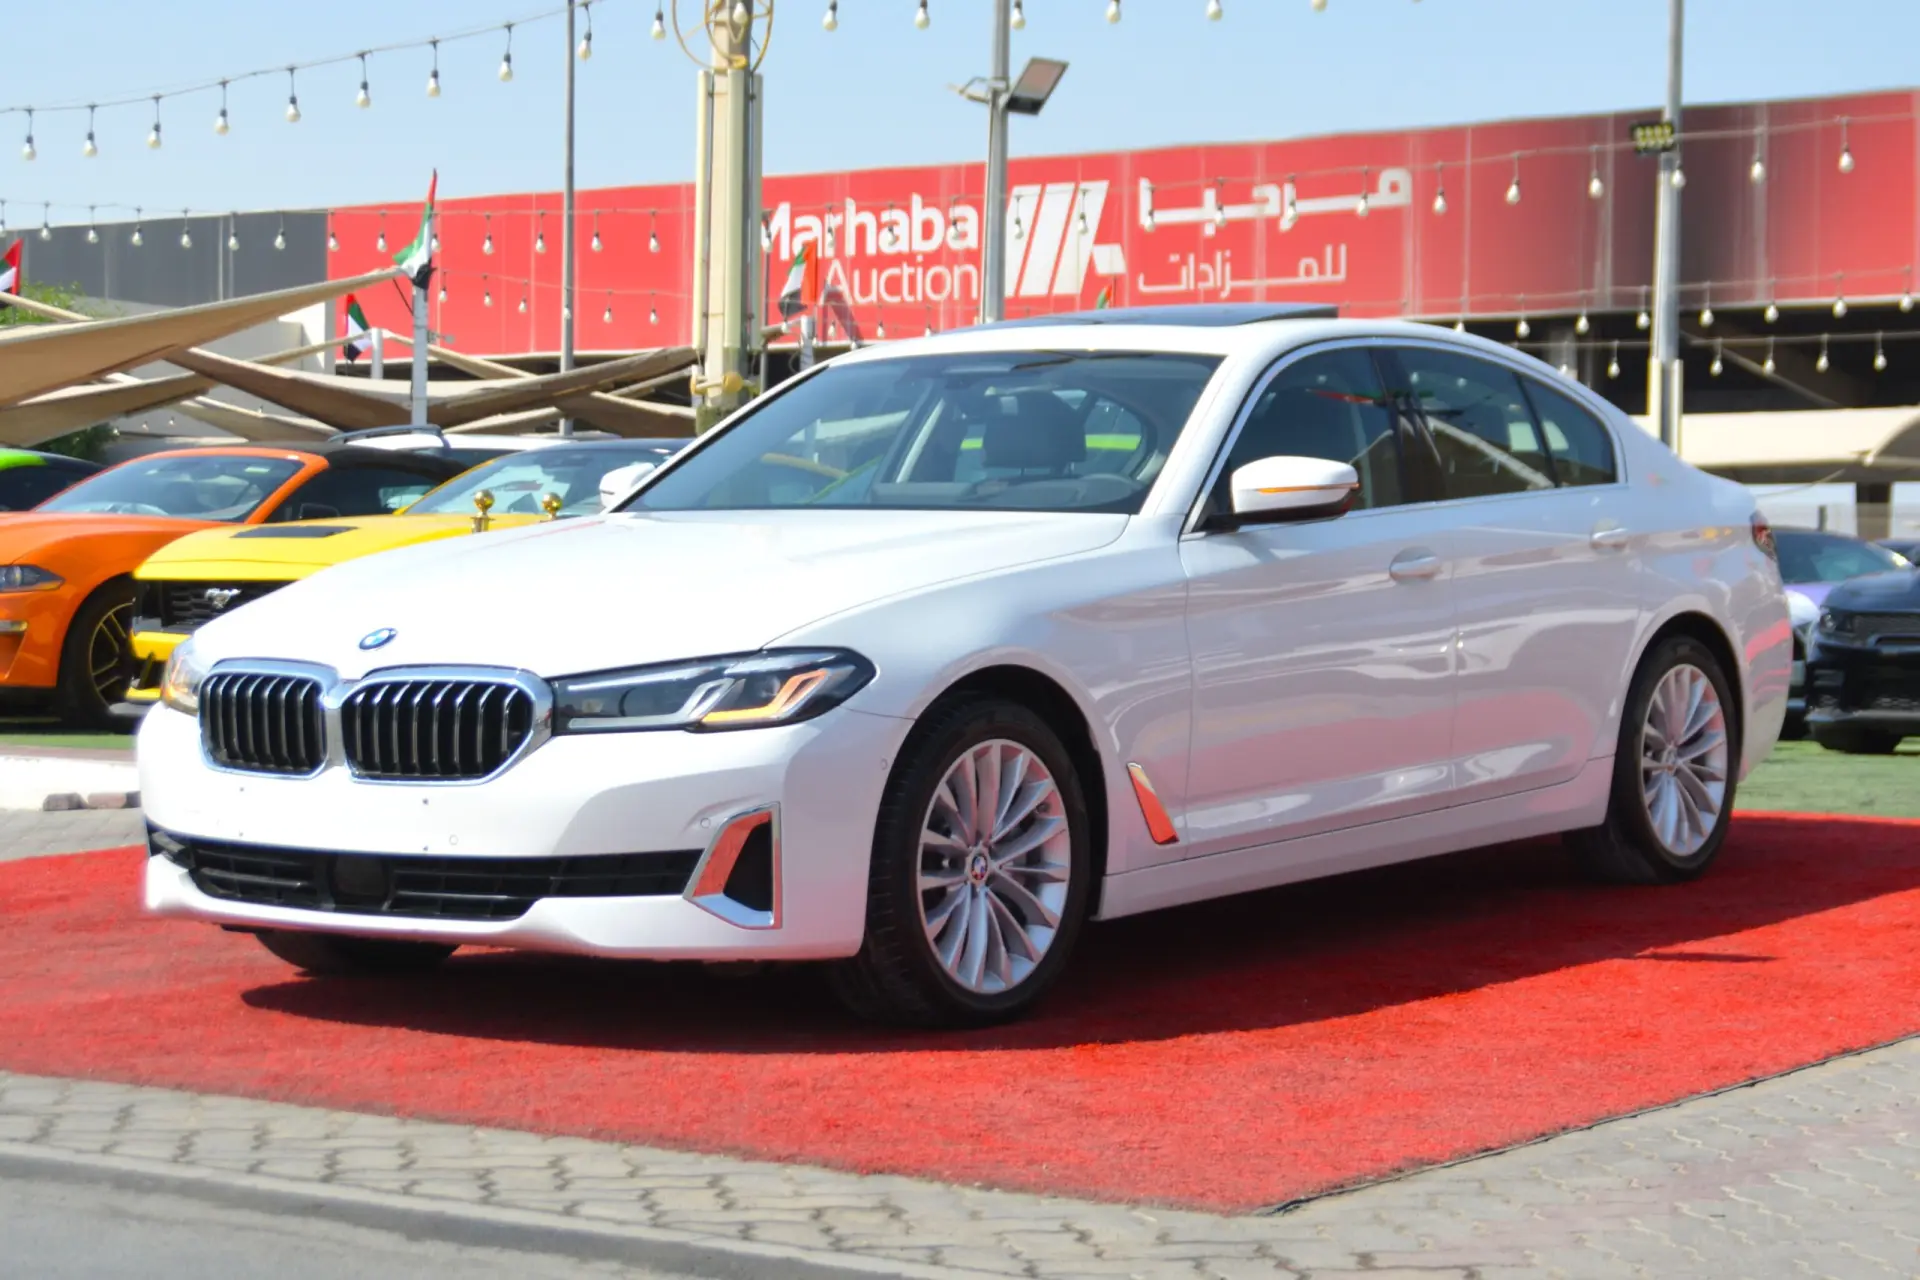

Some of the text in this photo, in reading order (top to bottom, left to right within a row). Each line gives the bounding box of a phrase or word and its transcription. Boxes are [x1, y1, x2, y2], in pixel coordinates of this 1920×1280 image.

[761, 192, 979, 261] Marhaba
[1138, 167, 1413, 237] مرحبا
[819, 254, 979, 306] Auction
[1137, 243, 1348, 299] للمزادات
